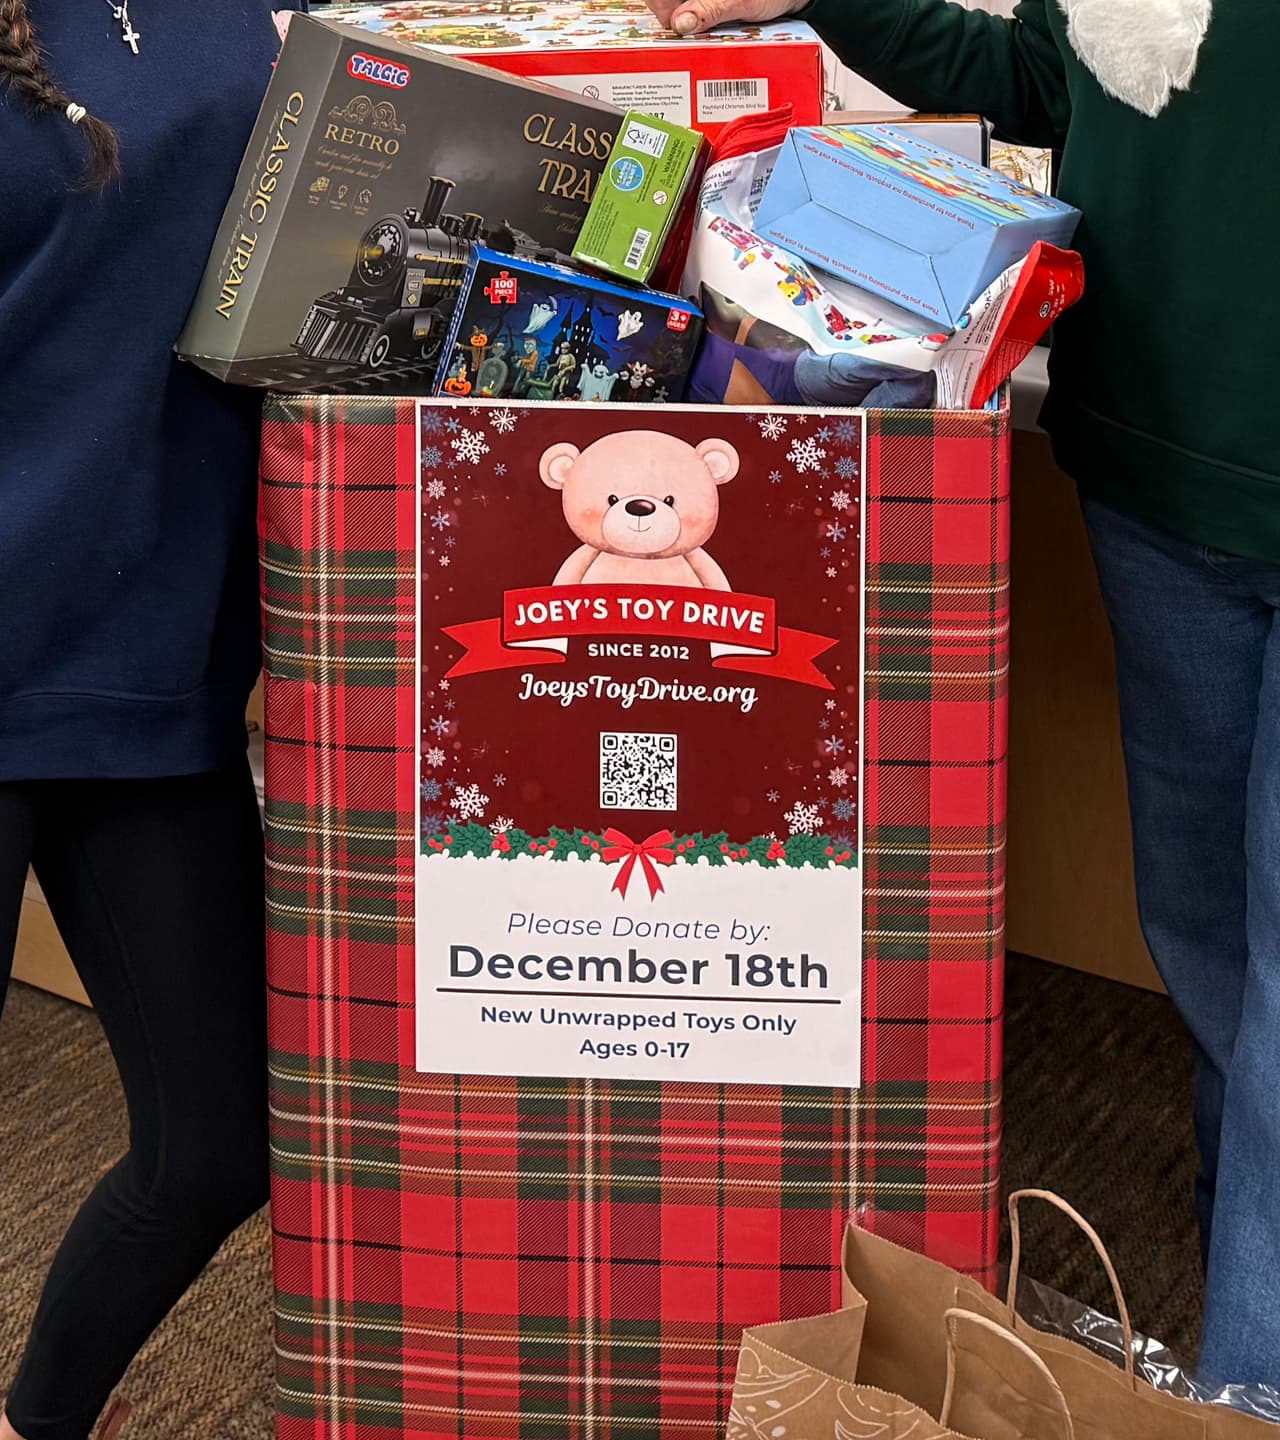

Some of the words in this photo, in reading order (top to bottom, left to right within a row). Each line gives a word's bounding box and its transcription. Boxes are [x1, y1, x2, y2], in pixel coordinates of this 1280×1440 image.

[324, 123, 401, 156] RETRO
[523, 113, 613, 160] CLASS
[248, 91, 305, 225] CLASSIC
[215, 232, 259, 320] TRAIN
[494, 279, 514, 290] 100
[494, 288, 514, 296] PIECE
[618, 599, 673, 620] TOY
[684, 602, 764, 633] DRIVE
[589, 644, 642, 656] SINCE
[650, 645, 689, 659] 2012
[519, 674, 758, 712] JoeysToyDrive.org
[508, 913, 601, 935] Please
[613, 917, 719, 939] Donate
[731, 919, 770, 945] by:
[450, 945, 708, 984] December
[725, 954, 827, 988] 18th
[482, 1007, 532, 1023] New
[541, 1008, 675, 1030] Unwrapped
[683, 1013, 735, 1033] Toys
[743, 1015, 796, 1035] Only
[580, 1039, 637, 1059] Ages
[645, 1042, 689, 1058] 0-17
